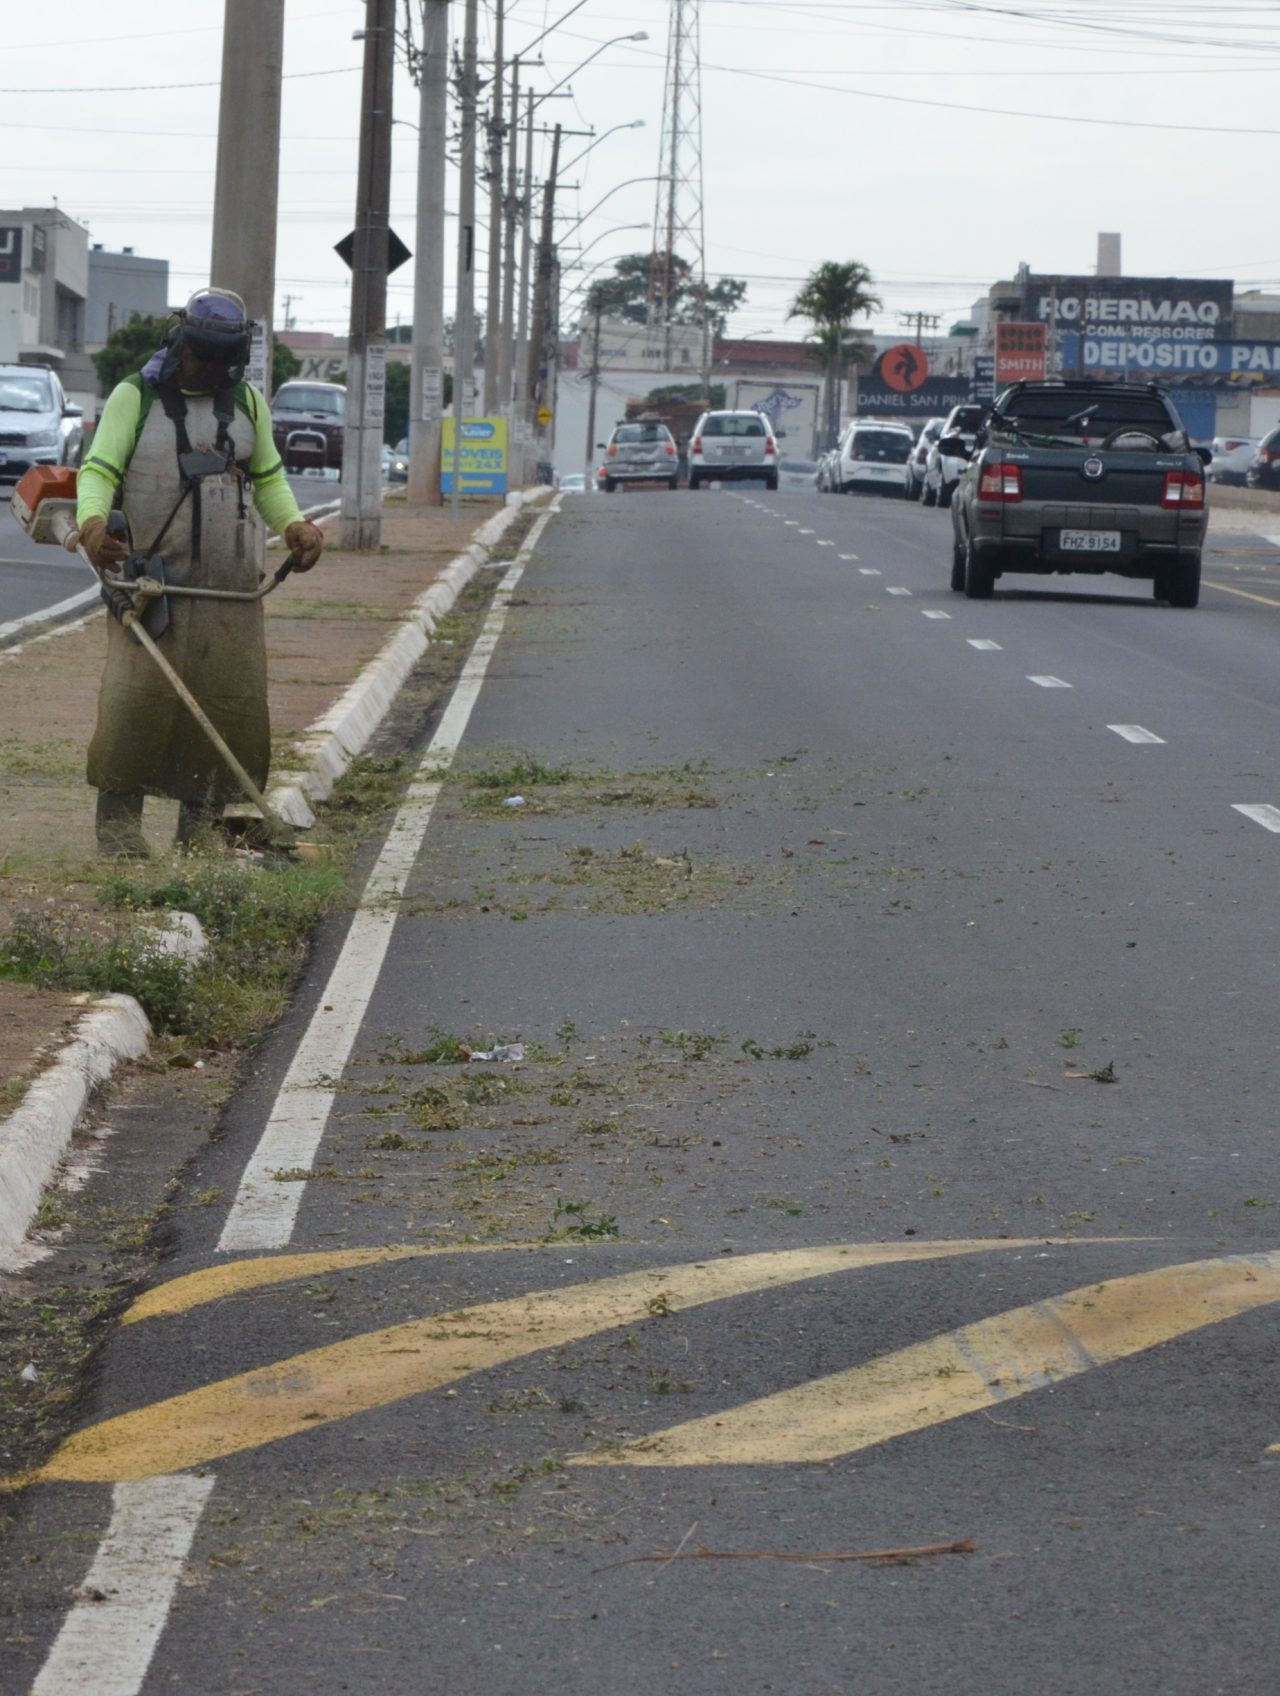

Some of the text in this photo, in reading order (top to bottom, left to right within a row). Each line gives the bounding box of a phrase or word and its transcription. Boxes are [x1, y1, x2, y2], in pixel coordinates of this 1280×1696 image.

[1083, 338, 1218, 367] DEPÓSITO
[999, 358, 1043, 371] SMITH
[858, 394, 906, 406] DANIEL
[910, 394, 938, 407] SAN
